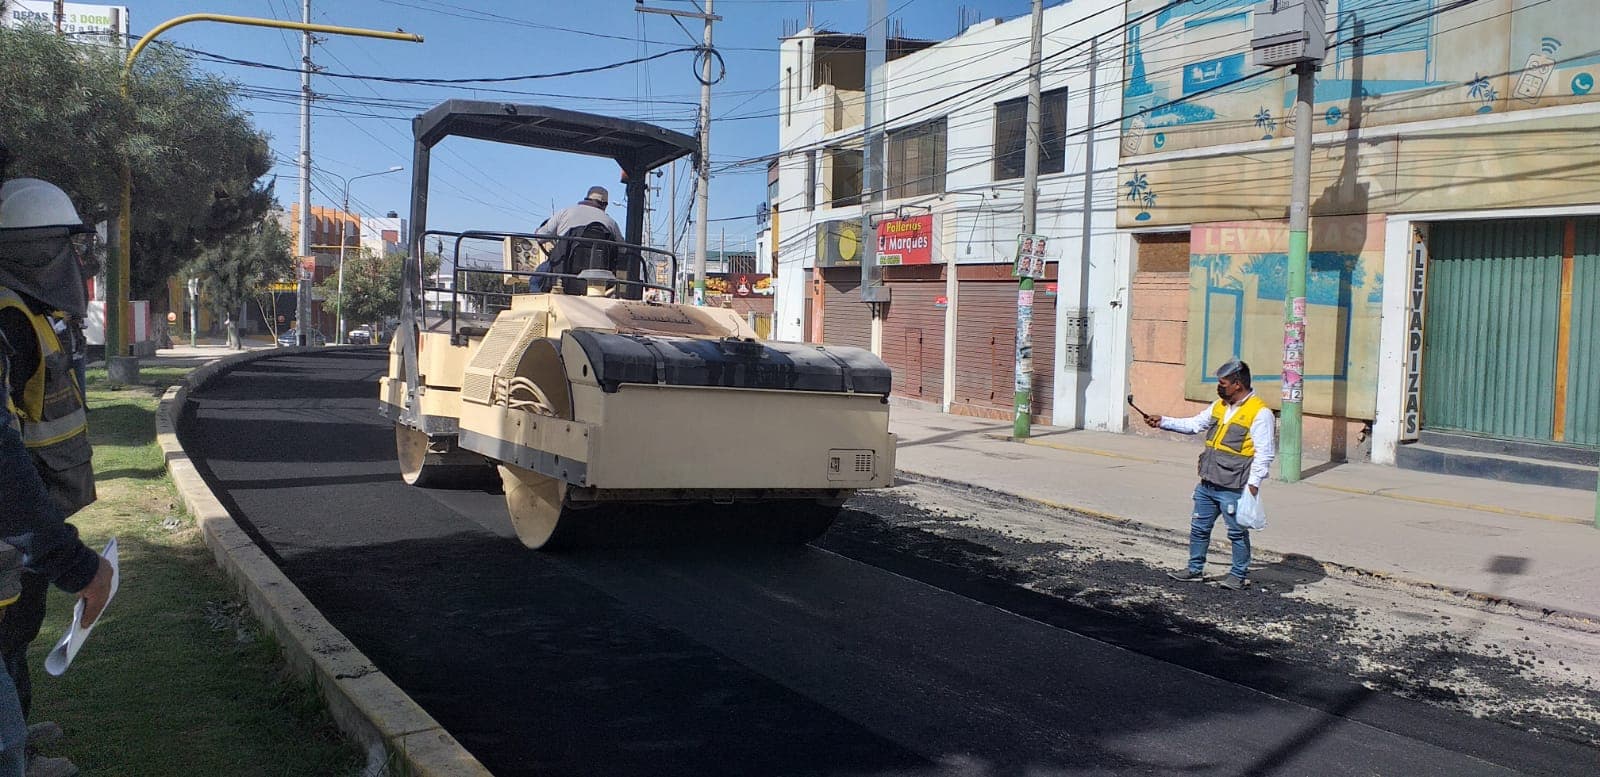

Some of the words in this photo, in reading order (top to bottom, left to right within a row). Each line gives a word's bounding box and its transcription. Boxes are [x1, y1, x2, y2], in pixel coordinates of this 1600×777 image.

[13, 10, 49, 21] DEPAS
[70, 14, 77, 23] 3
[879, 236, 887, 250] El
[1406, 249, 1424, 434] LEVADIZAS
[1289, 351, 1296, 360] 2
[1294, 390, 1302, 399] 2
